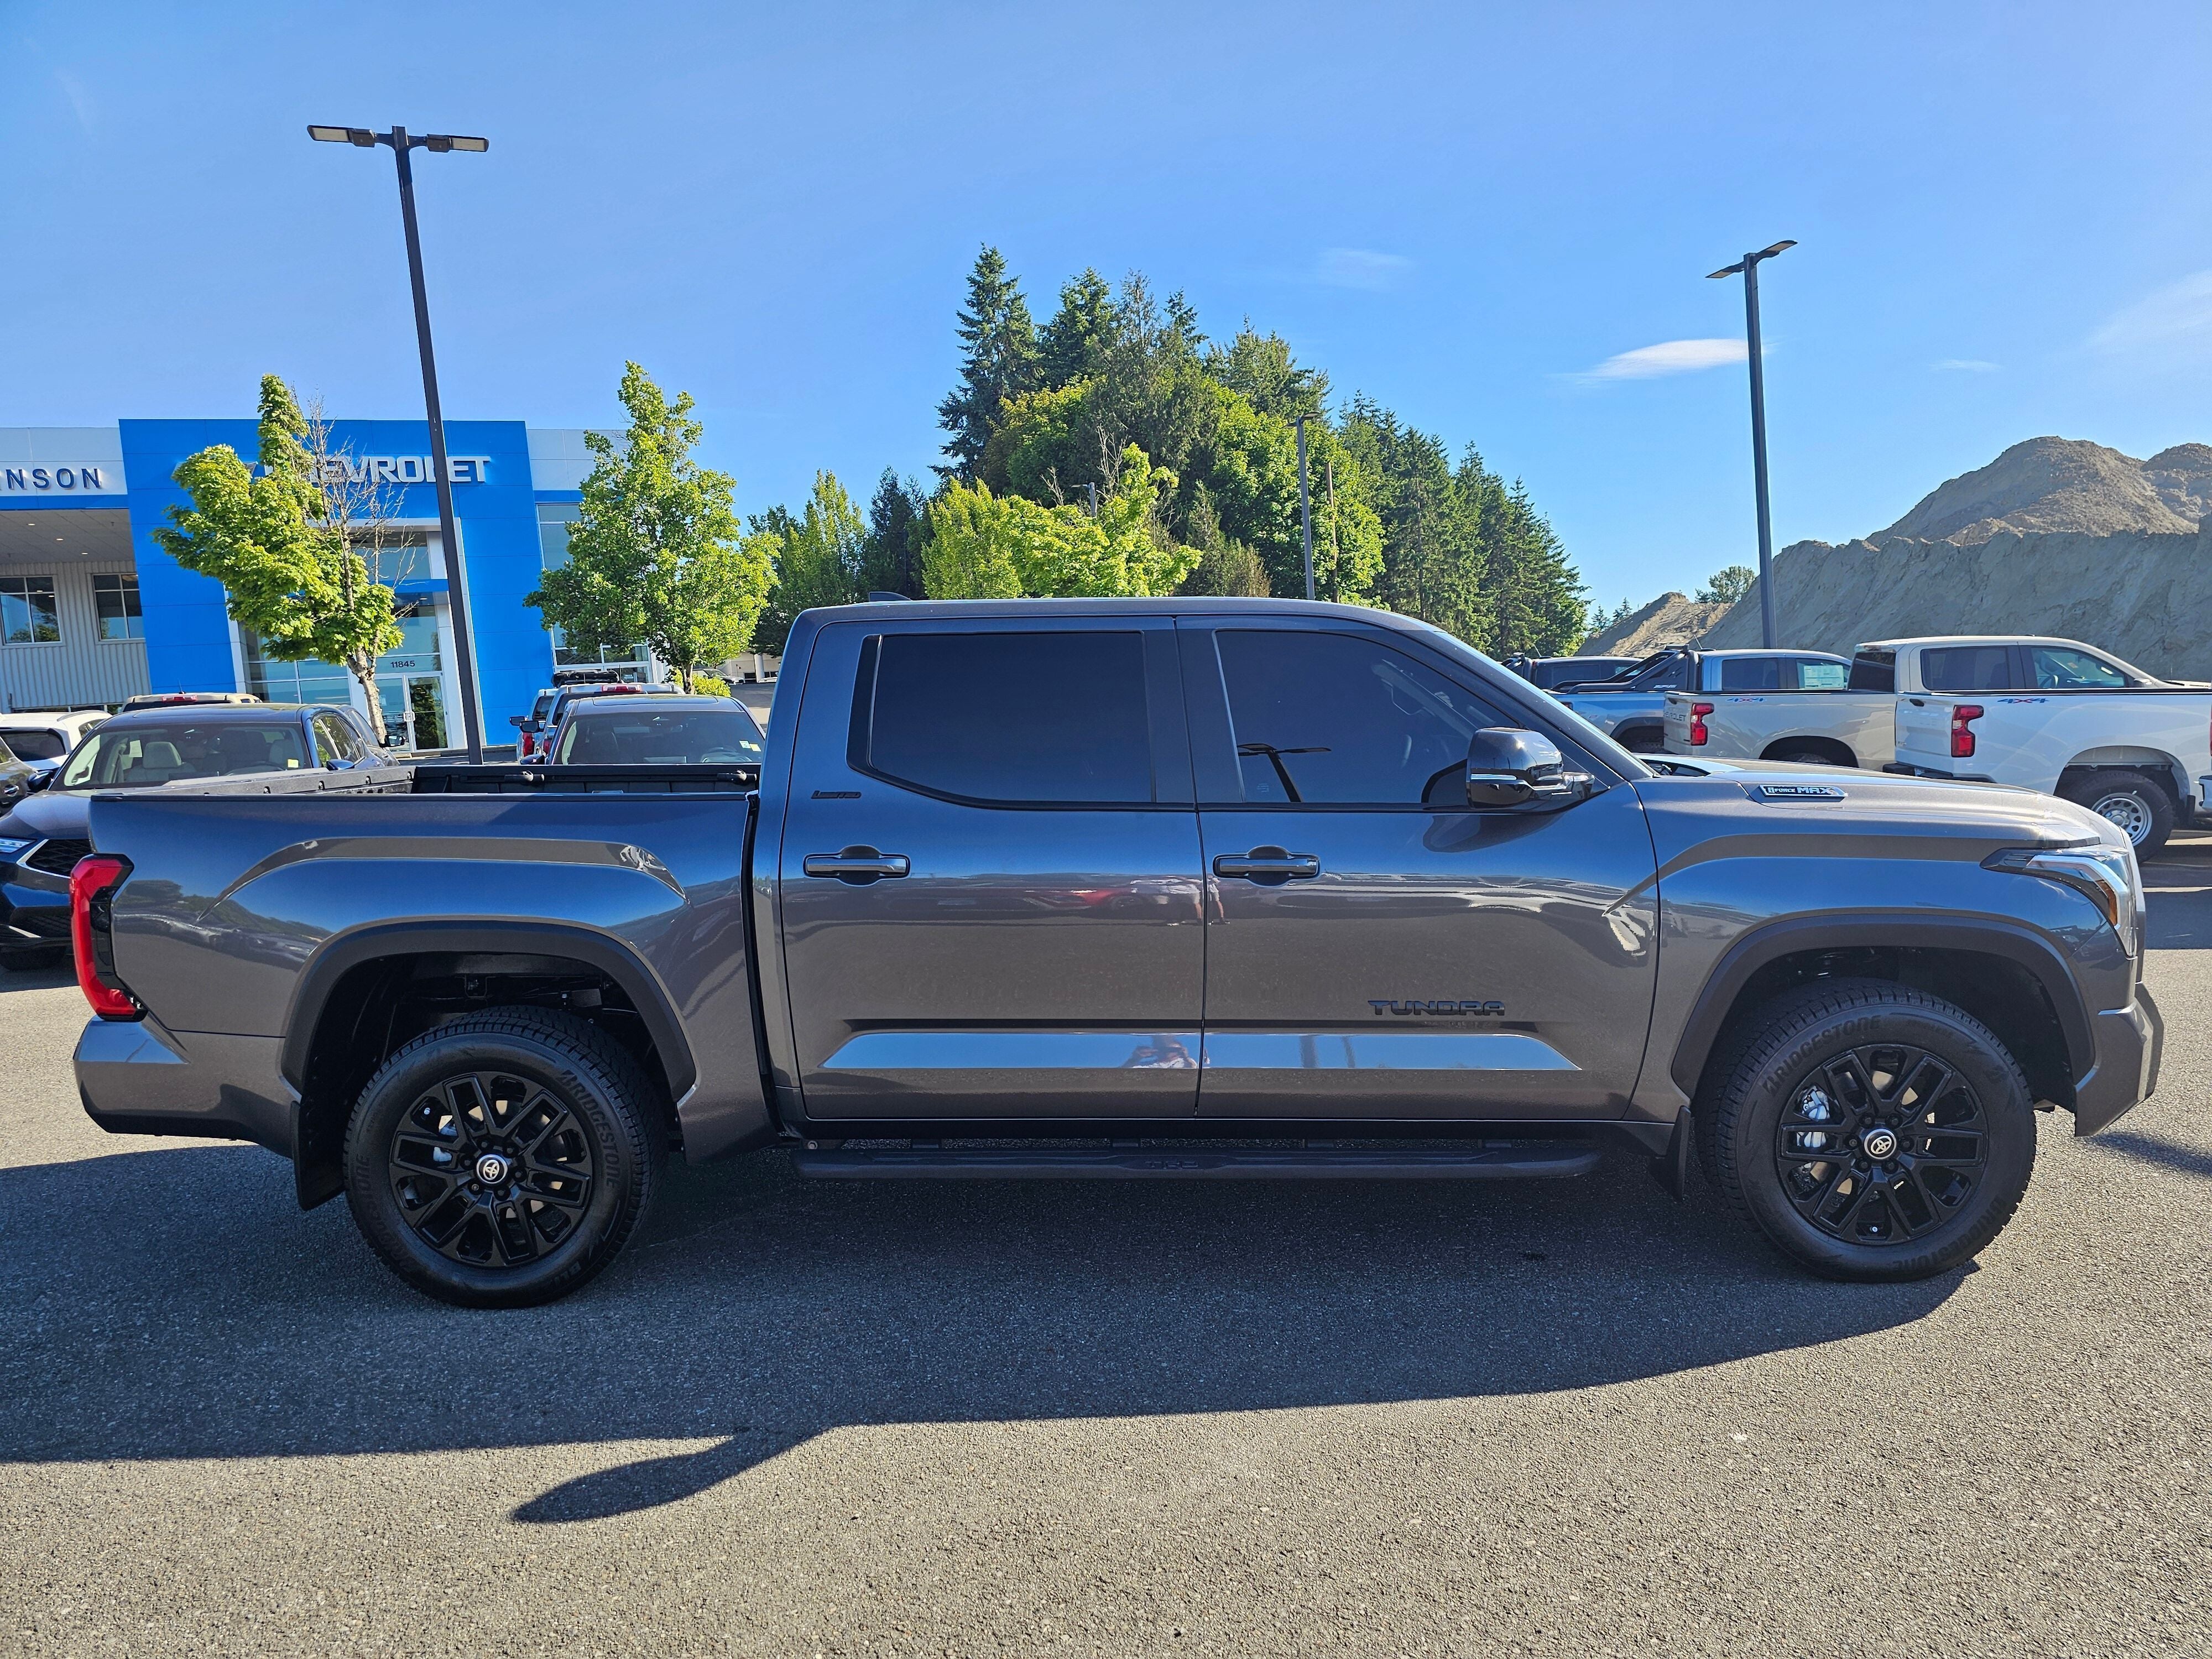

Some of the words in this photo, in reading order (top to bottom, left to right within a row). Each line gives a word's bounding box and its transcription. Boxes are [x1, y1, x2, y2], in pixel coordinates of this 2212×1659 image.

[1367, 1000, 1505, 1016] TUNDRA
[1762, 1015, 1882, 1097] BRIDGESTONE
[559, 1069, 621, 1193] BRIDGESTONE
